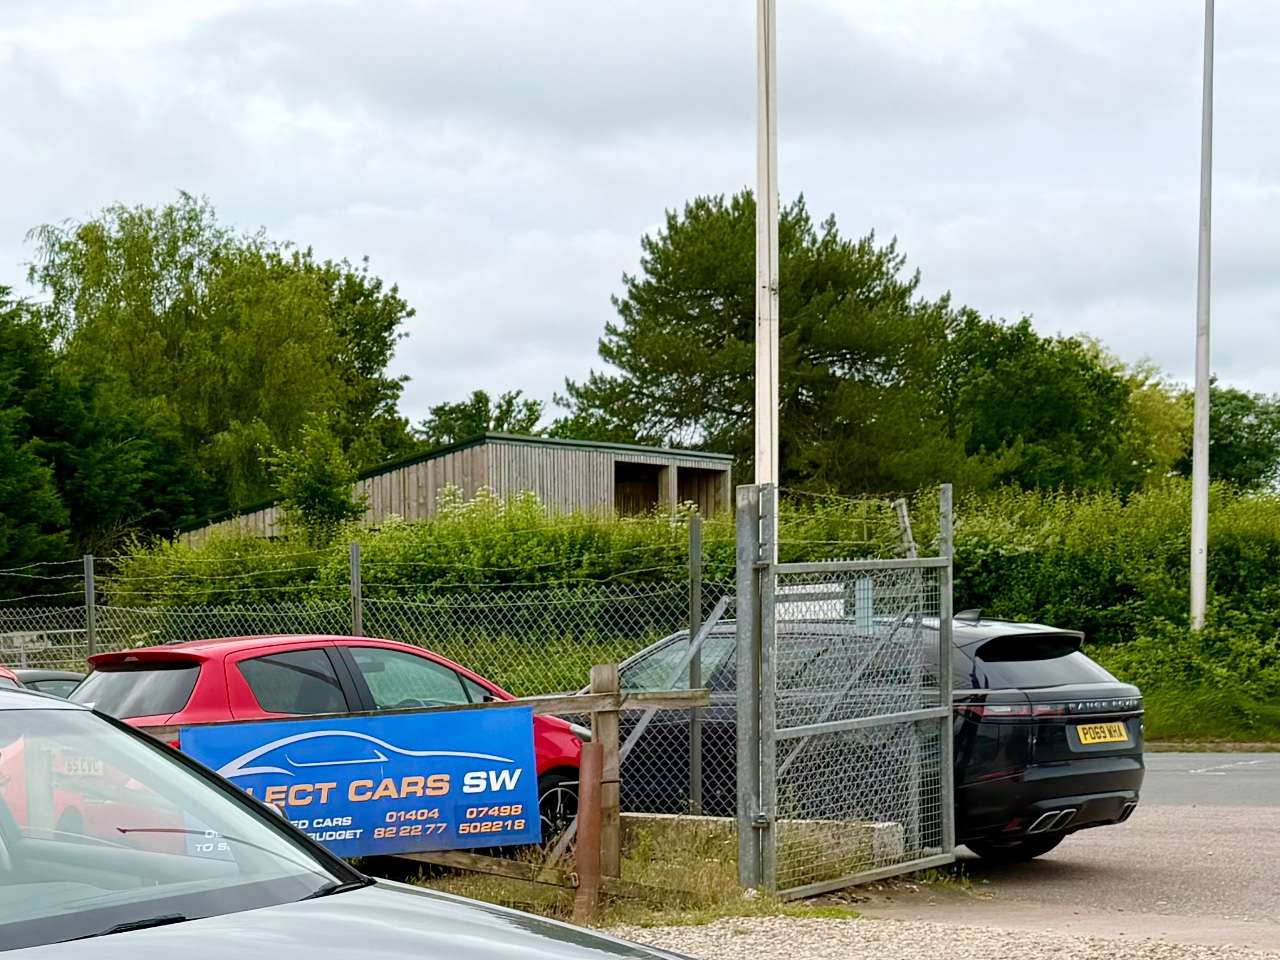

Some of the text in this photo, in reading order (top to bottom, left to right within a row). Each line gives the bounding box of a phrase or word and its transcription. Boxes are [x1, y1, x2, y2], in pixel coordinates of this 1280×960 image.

[243, 768, 522, 807] ECT CARS SW
[385, 808, 439, 822] 01404
[465, 804, 523, 819] 07498
[313, 816, 352, 828] CARS
[458, 819, 526, 834] 502218
